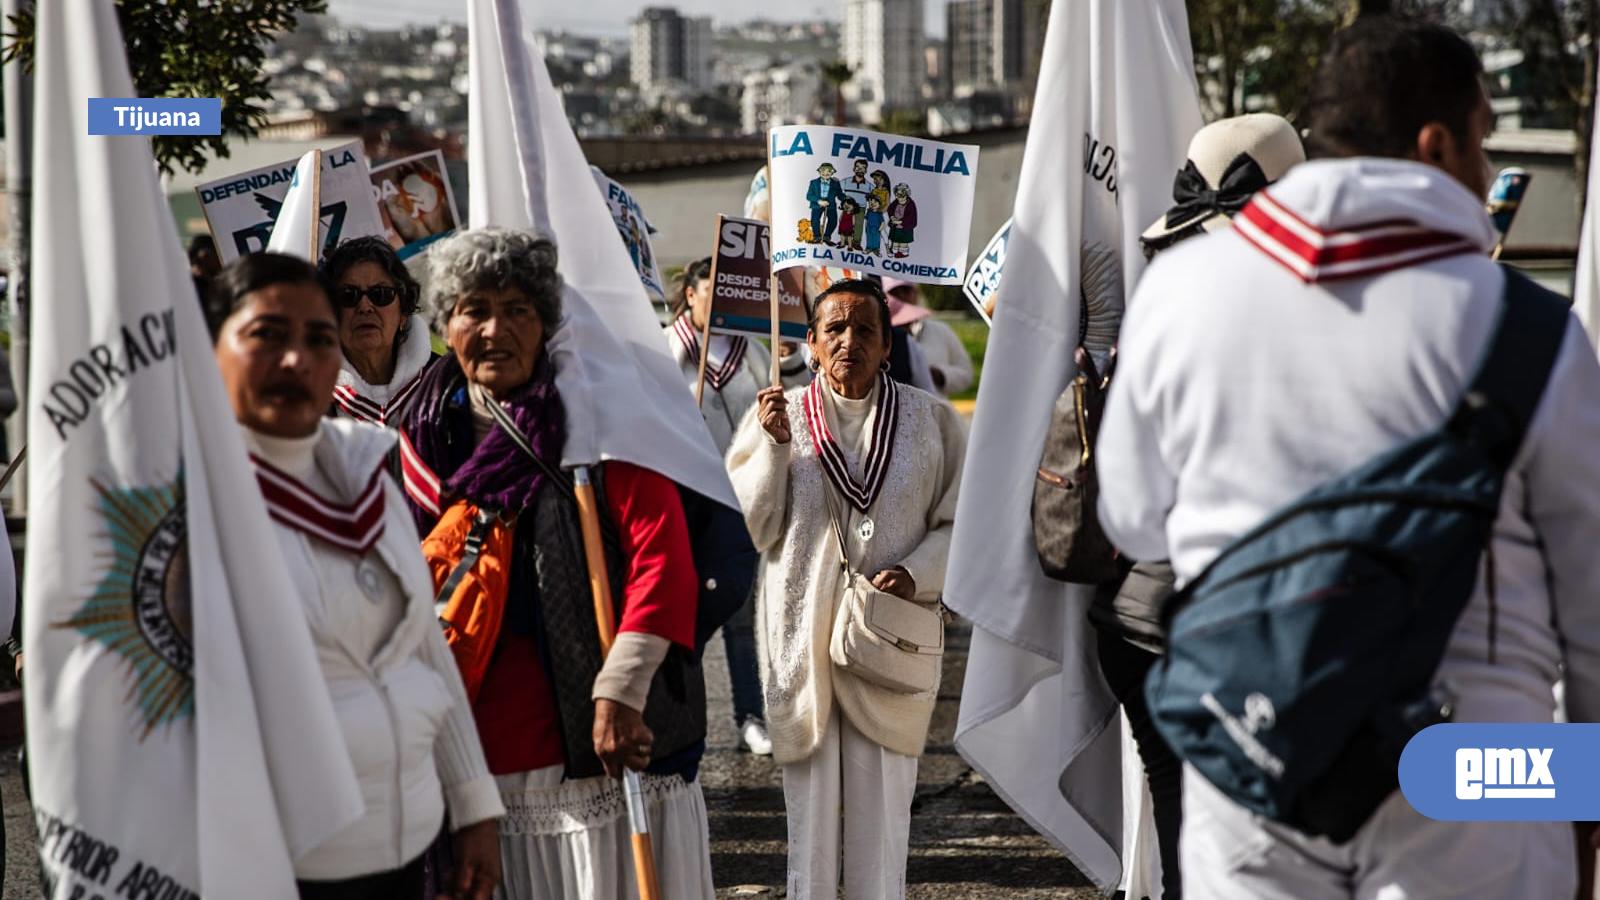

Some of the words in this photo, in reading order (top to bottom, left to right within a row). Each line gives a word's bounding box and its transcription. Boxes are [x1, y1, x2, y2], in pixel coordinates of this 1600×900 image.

[772, 131, 814, 158] LA
[831, 133, 970, 176] FAMILIA
[201, 165, 297, 204] DEFENDAM
[329, 150, 355, 168] LA
[719, 222, 757, 260] SI
[717, 273, 760, 288] DESDE
[813, 247, 834, 260] LA
[841, 251, 875, 268] VIDA
[882, 259, 958, 278] COMIENZA
[716, 286, 800, 306] CONCEPIÓN
[42, 307, 176, 441] ADORACI
